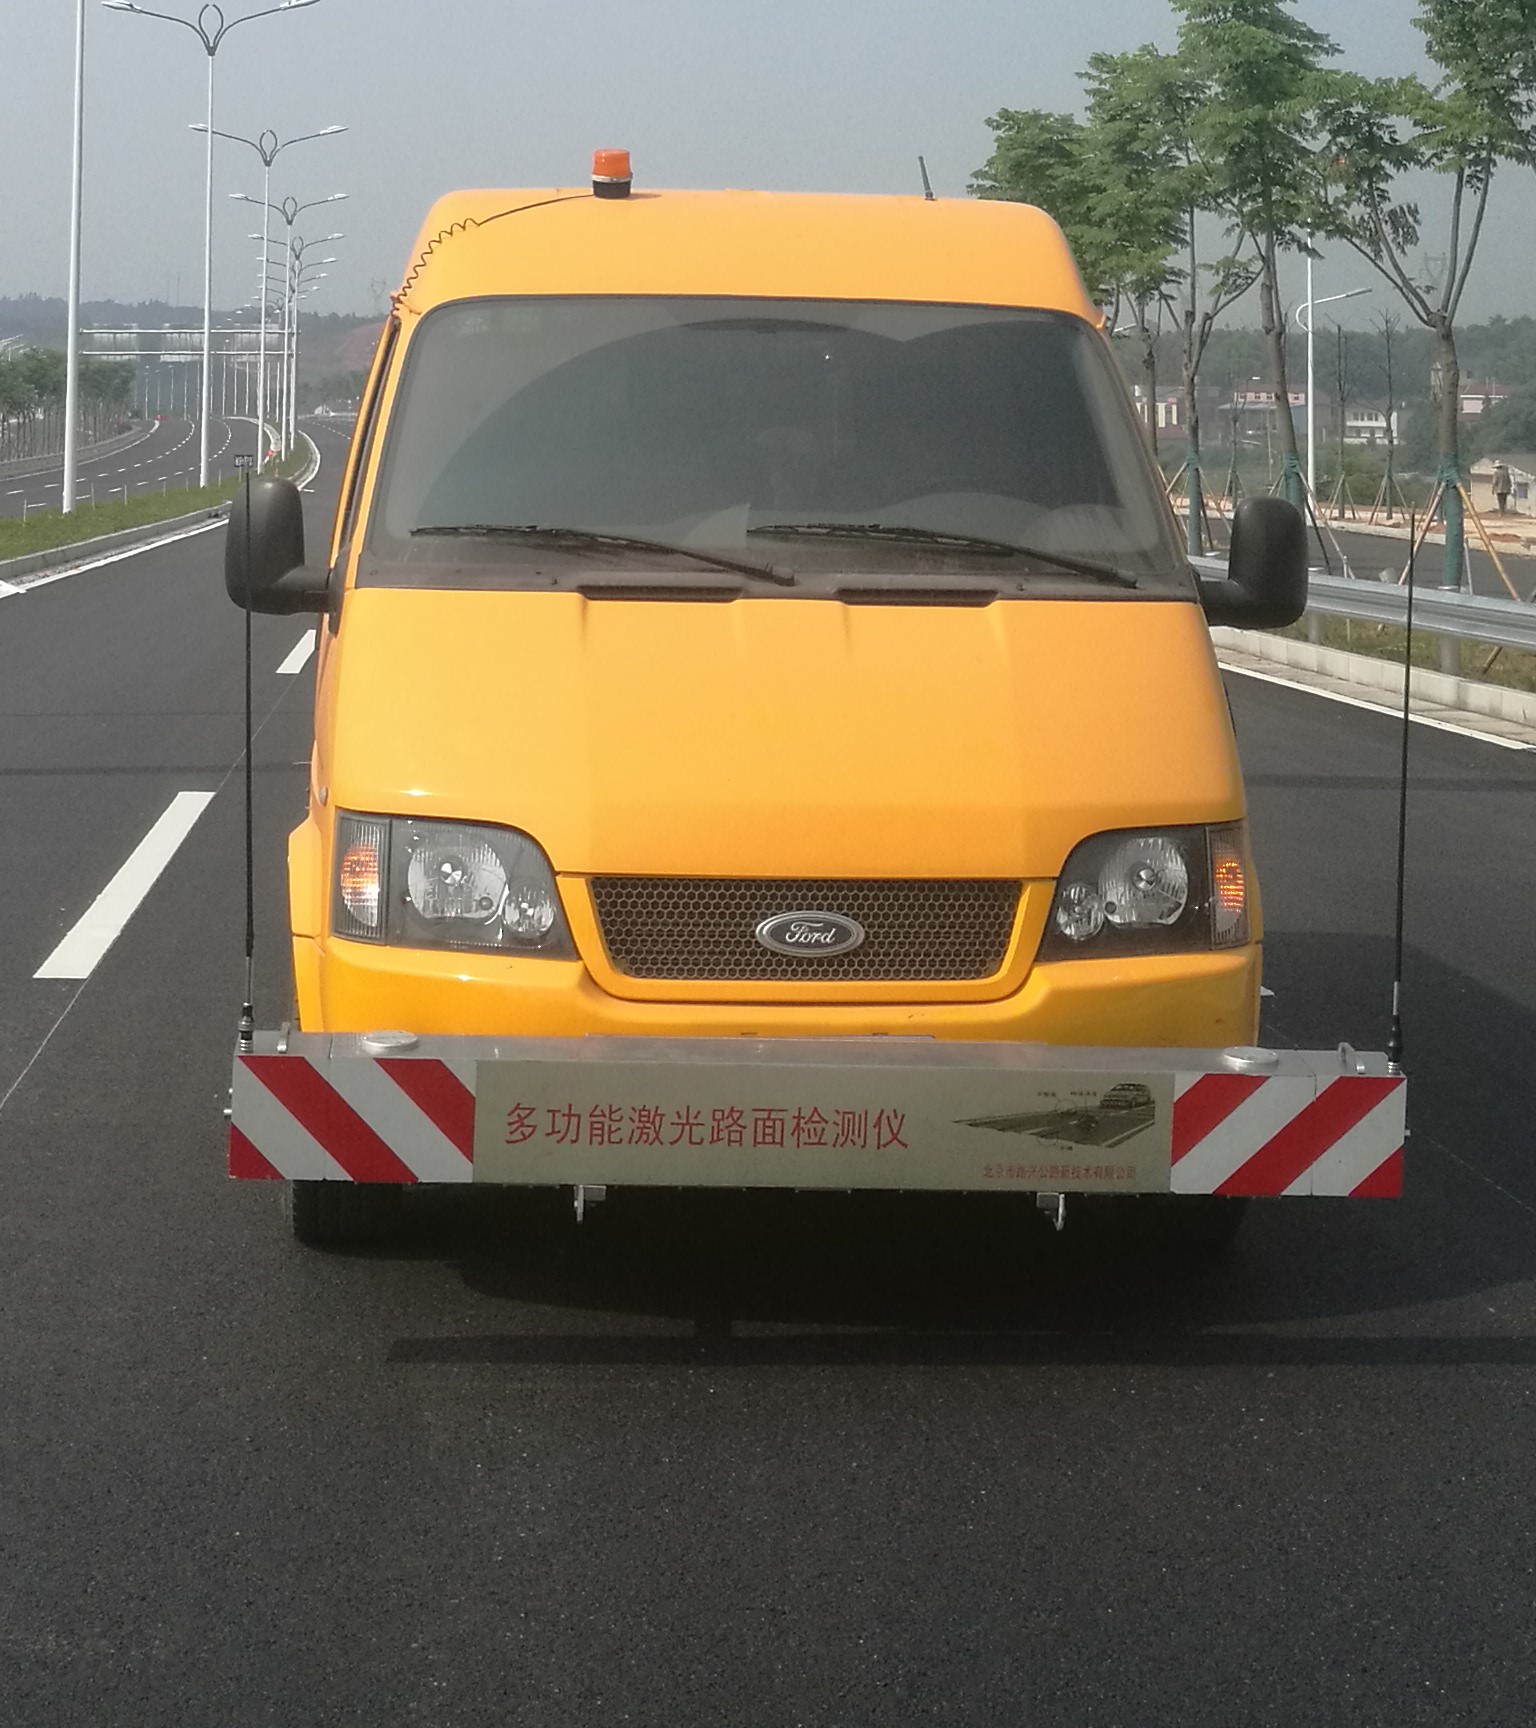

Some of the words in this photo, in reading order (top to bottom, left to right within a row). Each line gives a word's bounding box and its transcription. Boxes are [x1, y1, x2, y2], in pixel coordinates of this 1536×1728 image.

[785, 921, 836, 943] Ford
[504, 1101, 909, 1150] 多功能激光路面检测仪
